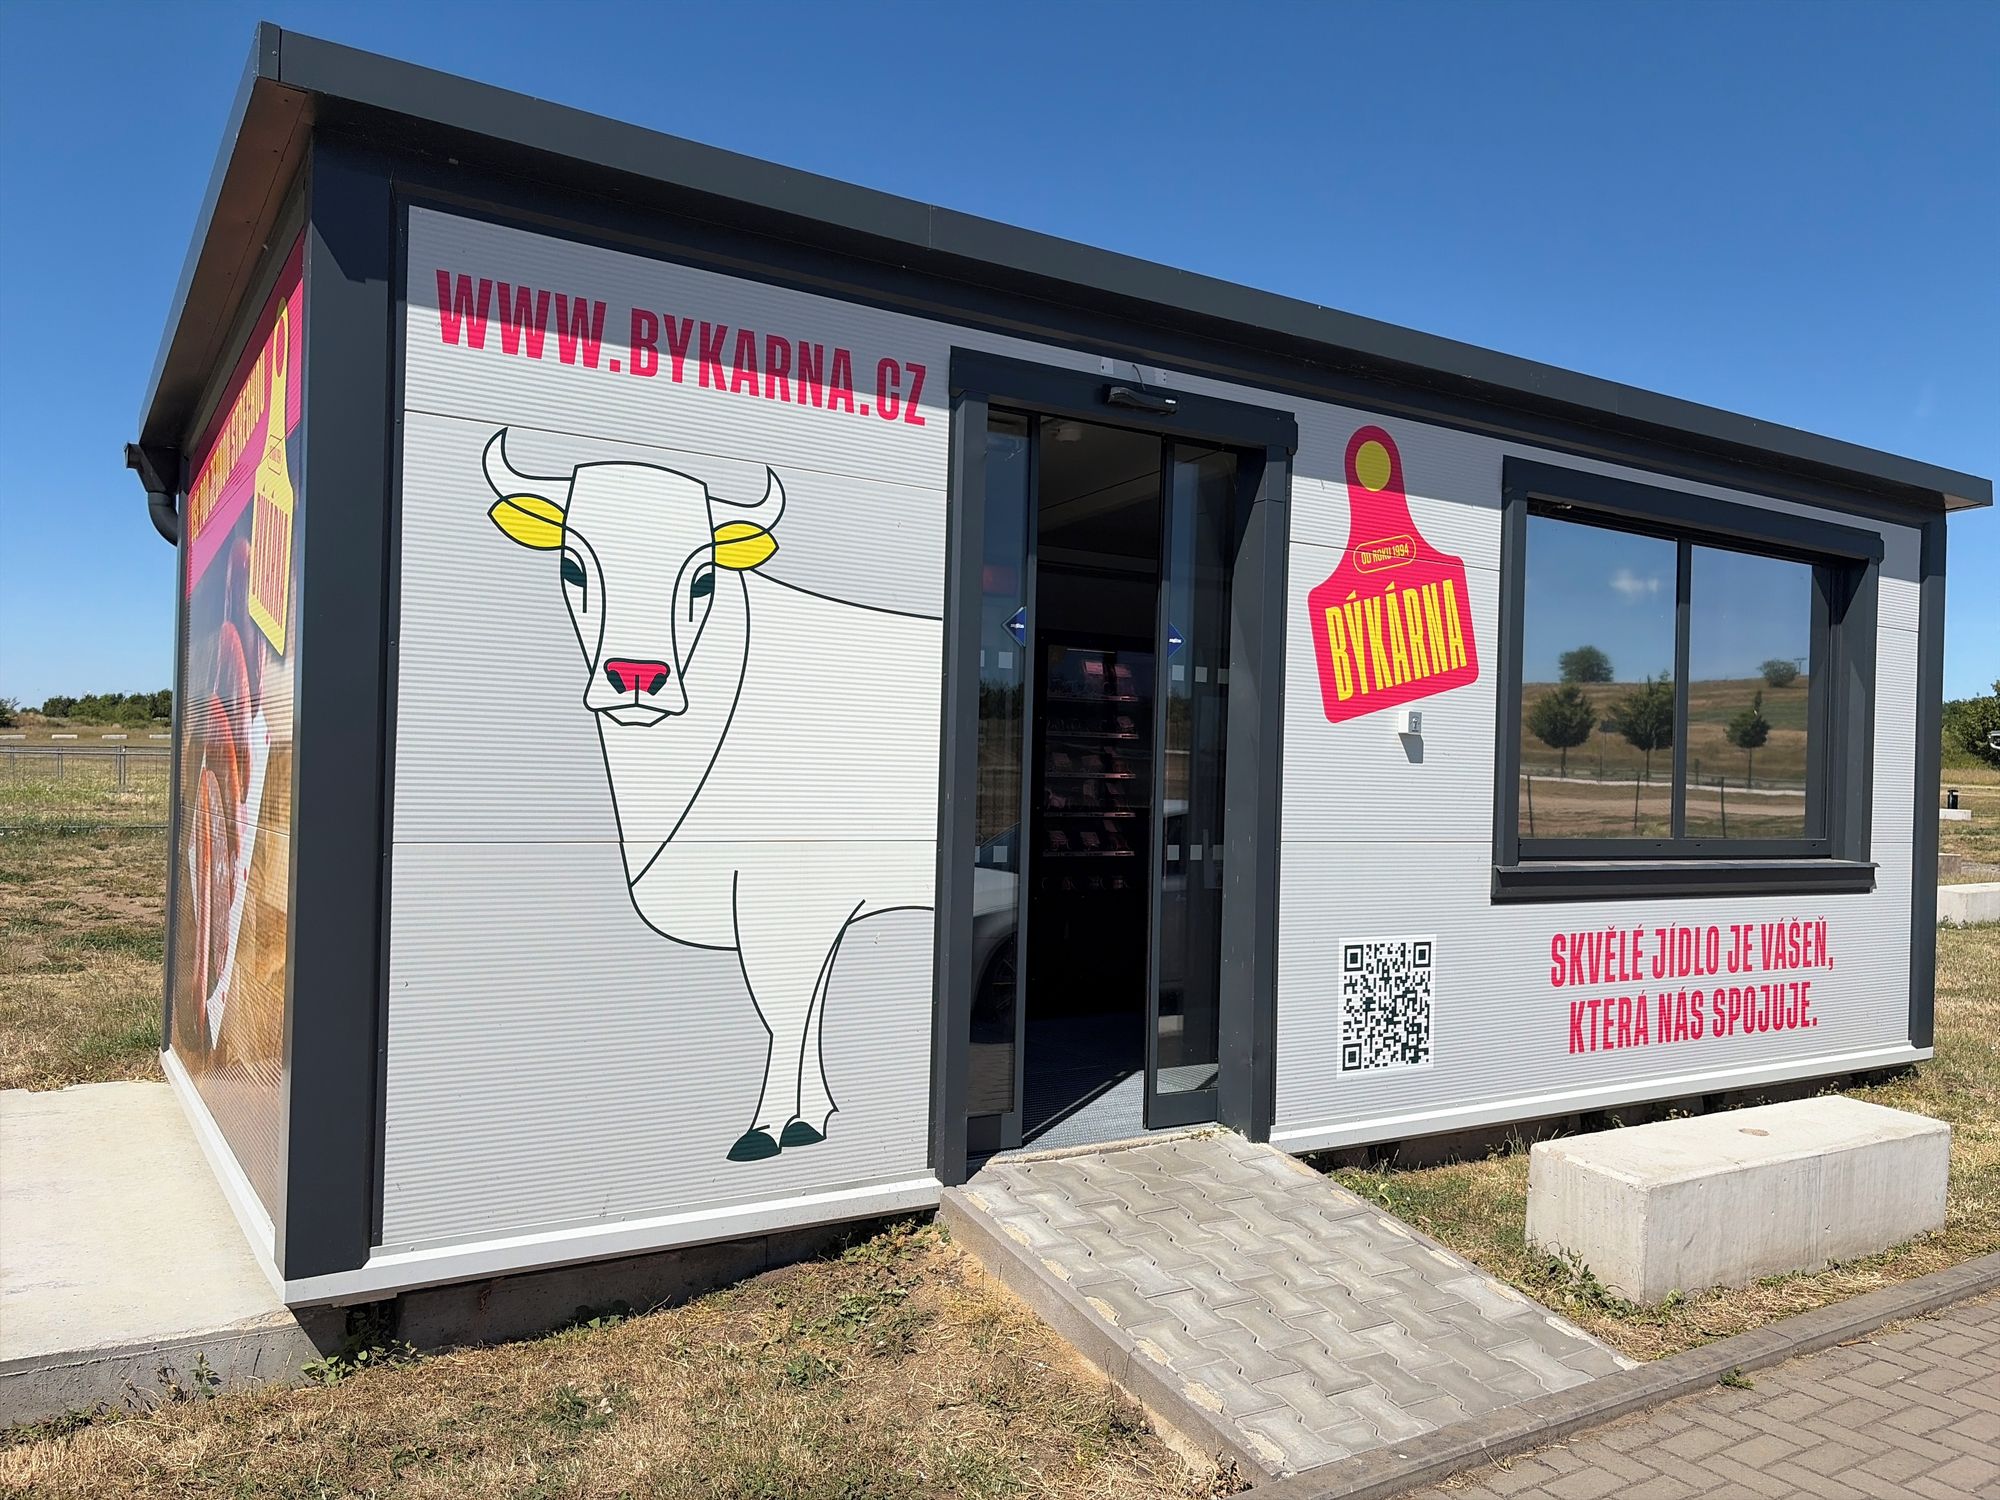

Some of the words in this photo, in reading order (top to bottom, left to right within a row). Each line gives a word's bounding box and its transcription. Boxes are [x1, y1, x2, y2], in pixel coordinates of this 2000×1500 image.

[436, 269, 926, 426] WWW.BYKARNA.CZ
[1361, 551, 1372, 565] OD
[1372, 545, 1392, 562] ROKU
[1392, 543, 1410, 557] 1994
[1325, 579, 1468, 701] BÝKÁRNA
[1550, 924, 1644, 988] SKVĚLÉ
[1652, 922, 1720, 980] JÍDLO
[1727, 924, 1754, 974] JE
[1760, 915, 1834, 971] VÁŠEŇ,
[1569, 989, 1649, 1054] KTERÁ
[1657, 986, 1704, 1044] NÁS
[1712, 981, 1818, 1038] SPOJUJE.
